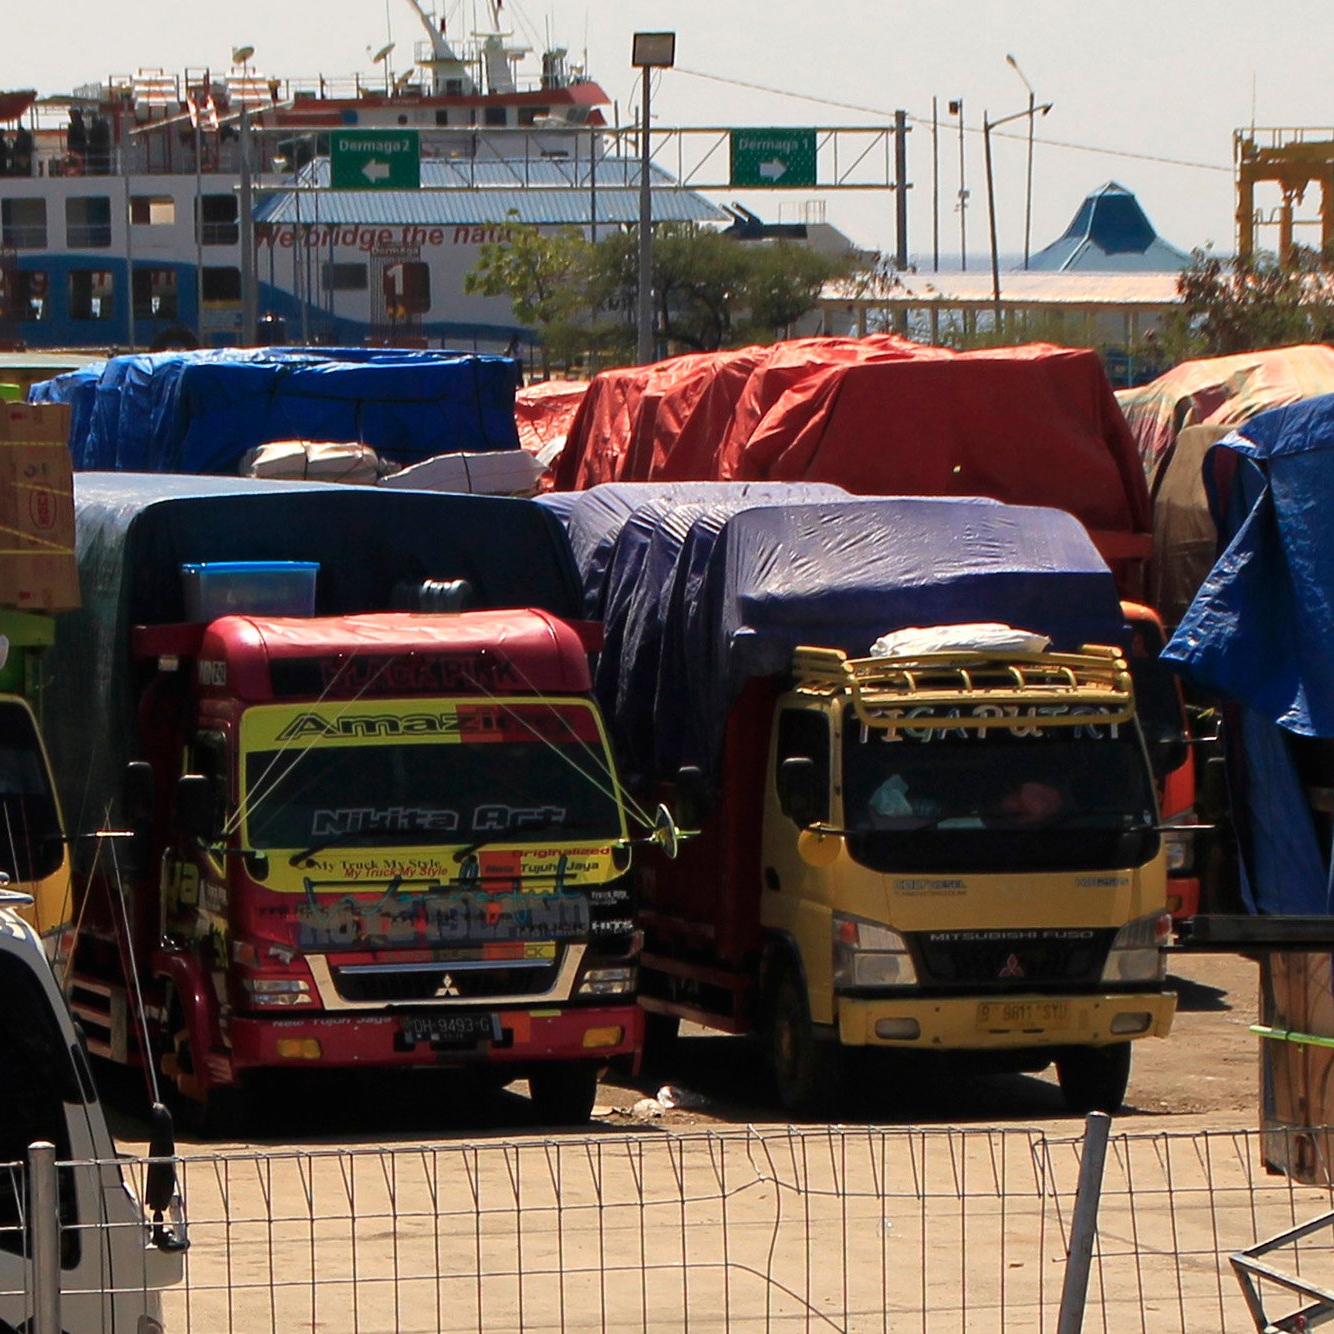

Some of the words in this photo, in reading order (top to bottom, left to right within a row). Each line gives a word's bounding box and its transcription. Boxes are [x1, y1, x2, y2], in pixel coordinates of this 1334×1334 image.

[339, 139, 400, 155] Dermaga
[402, 140, 411, 152] 2
[738, 138, 799, 155] Dermaga
[803, 139, 809, 151] 1
[302, 222, 394, 252] bridge
[401, 222, 445, 248] the
[386, 264, 404, 296] 1
[311, 806, 459, 836] Nikita
[472, 803, 566, 830] Art
[339, 859, 380, 870] Truck
[382, 859, 406, 870] My
[408, 856, 442, 870] Style
[363, 866, 398, 877] Truck
[399, 866, 418, 878] My
[419, 864, 448, 877] Style
[567, 860, 599, 873] Jaya
[930, 931, 1037, 942] MITSUBISHI
[1042, 930, 1095, 941] FUSO
